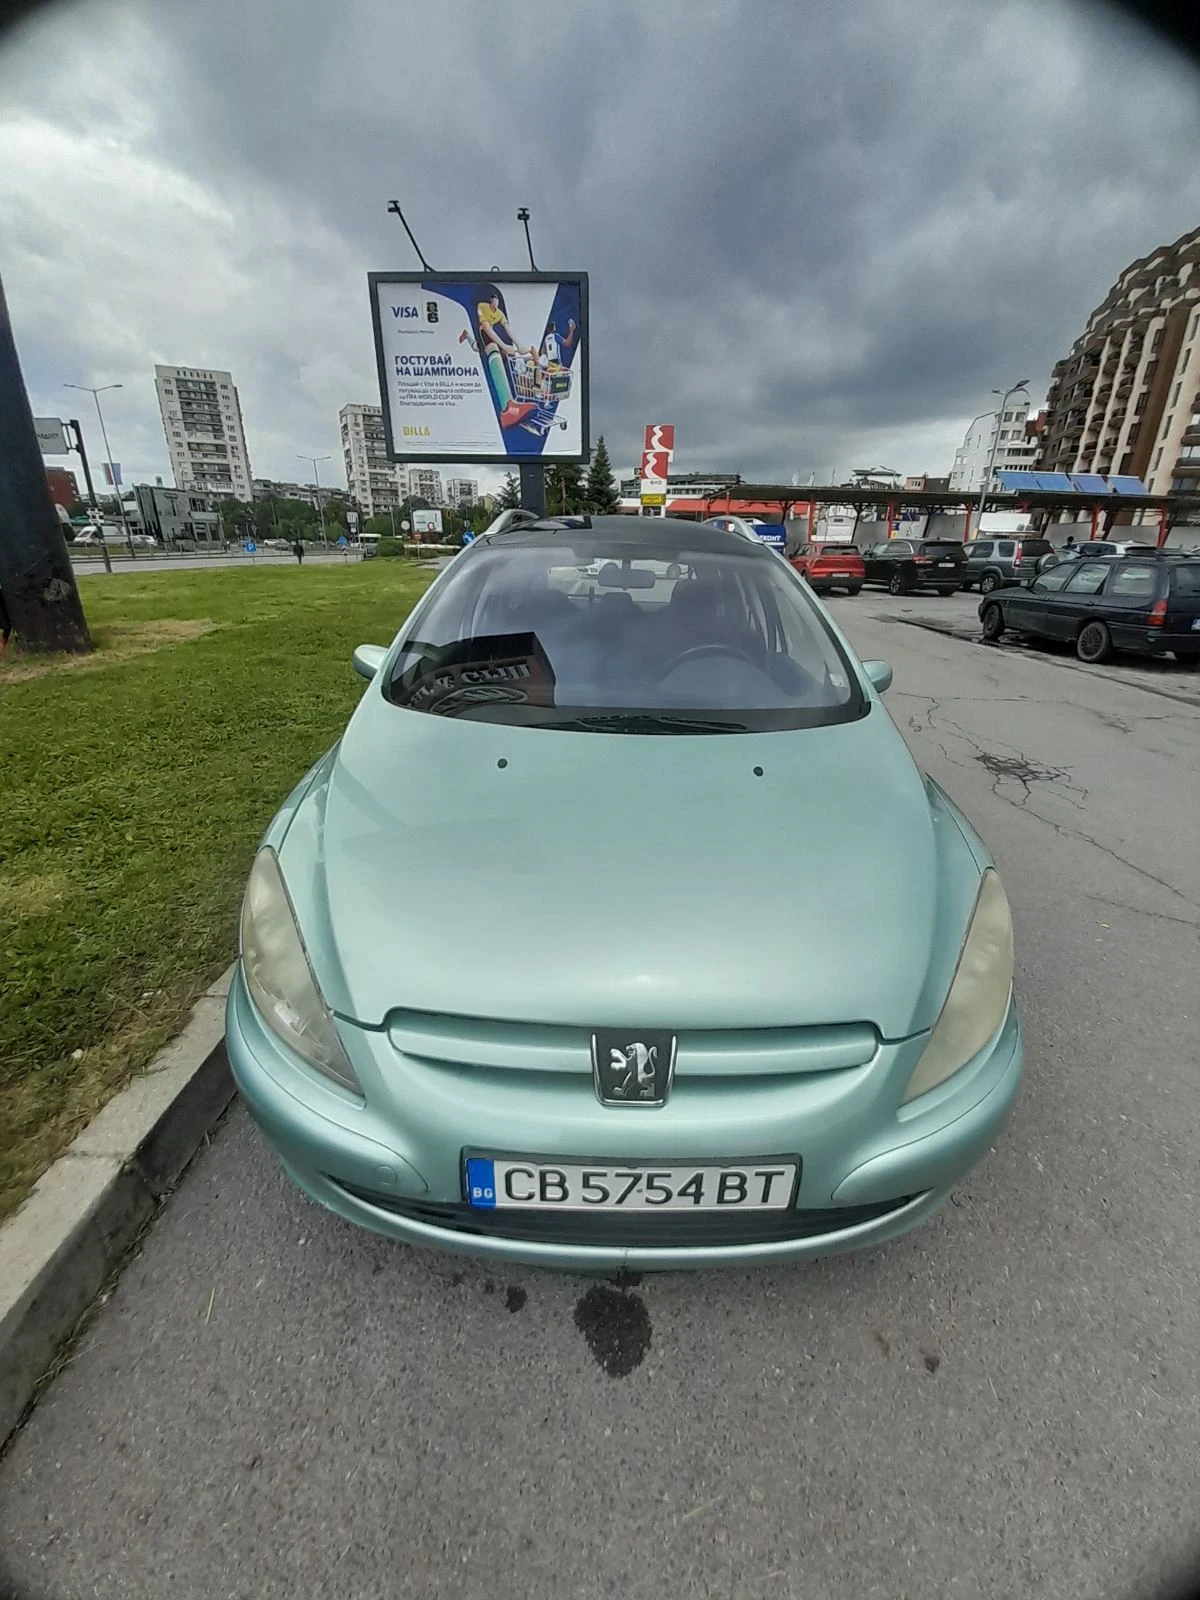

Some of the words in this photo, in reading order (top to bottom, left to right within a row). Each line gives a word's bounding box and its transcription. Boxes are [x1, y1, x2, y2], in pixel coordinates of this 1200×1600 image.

[391, 306, 419, 318] VISA
[394, 354, 452, 365] ГОСТУВАЙ
[396, 367, 411, 376] НА
[413, 367, 480, 376] ШАМПИОНА
[402, 426, 431, 436] BILLA
[472, 1187, 493, 1199] BG
[504, 1167, 570, 1201] CB
[582, 1171, 705, 1205] 5754
[716, 1170, 786, 1204] BT
